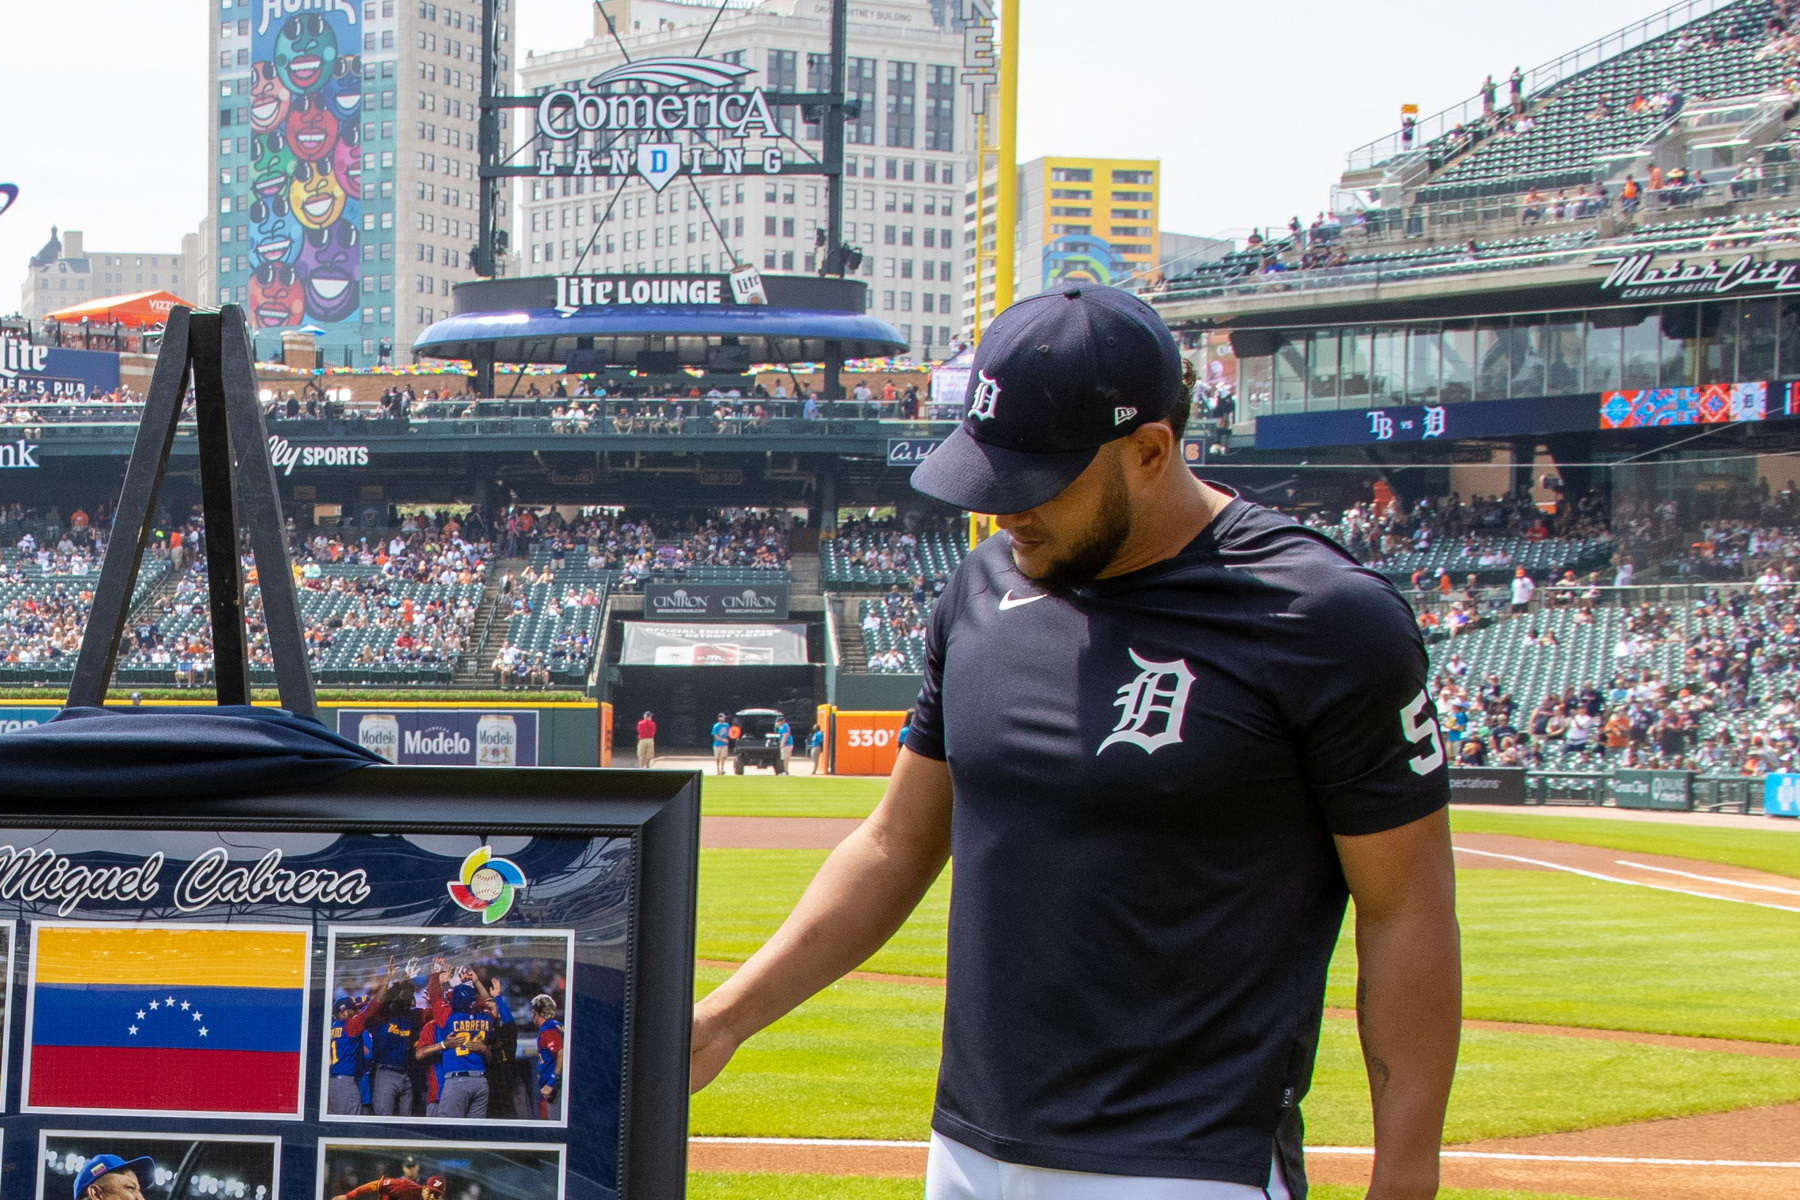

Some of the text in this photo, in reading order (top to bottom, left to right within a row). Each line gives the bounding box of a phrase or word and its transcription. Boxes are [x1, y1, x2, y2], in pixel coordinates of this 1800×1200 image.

[539, 148, 782, 174] LANDING
[554, 277, 722, 318] Lite LOUNGE
[54, 381, 85, 397] PUB
[967, 369, 1001, 421] D
[303, 446, 369, 466] SPORTS
[1096, 647, 1197, 756] D
[361, 730, 396, 744] Modelo
[404, 730, 471, 755] Modelo
[479, 730, 514, 745] Modelo
[173, 846, 371, 913] Cabrera
[453, 1020, 489, 1032] CABRERA
